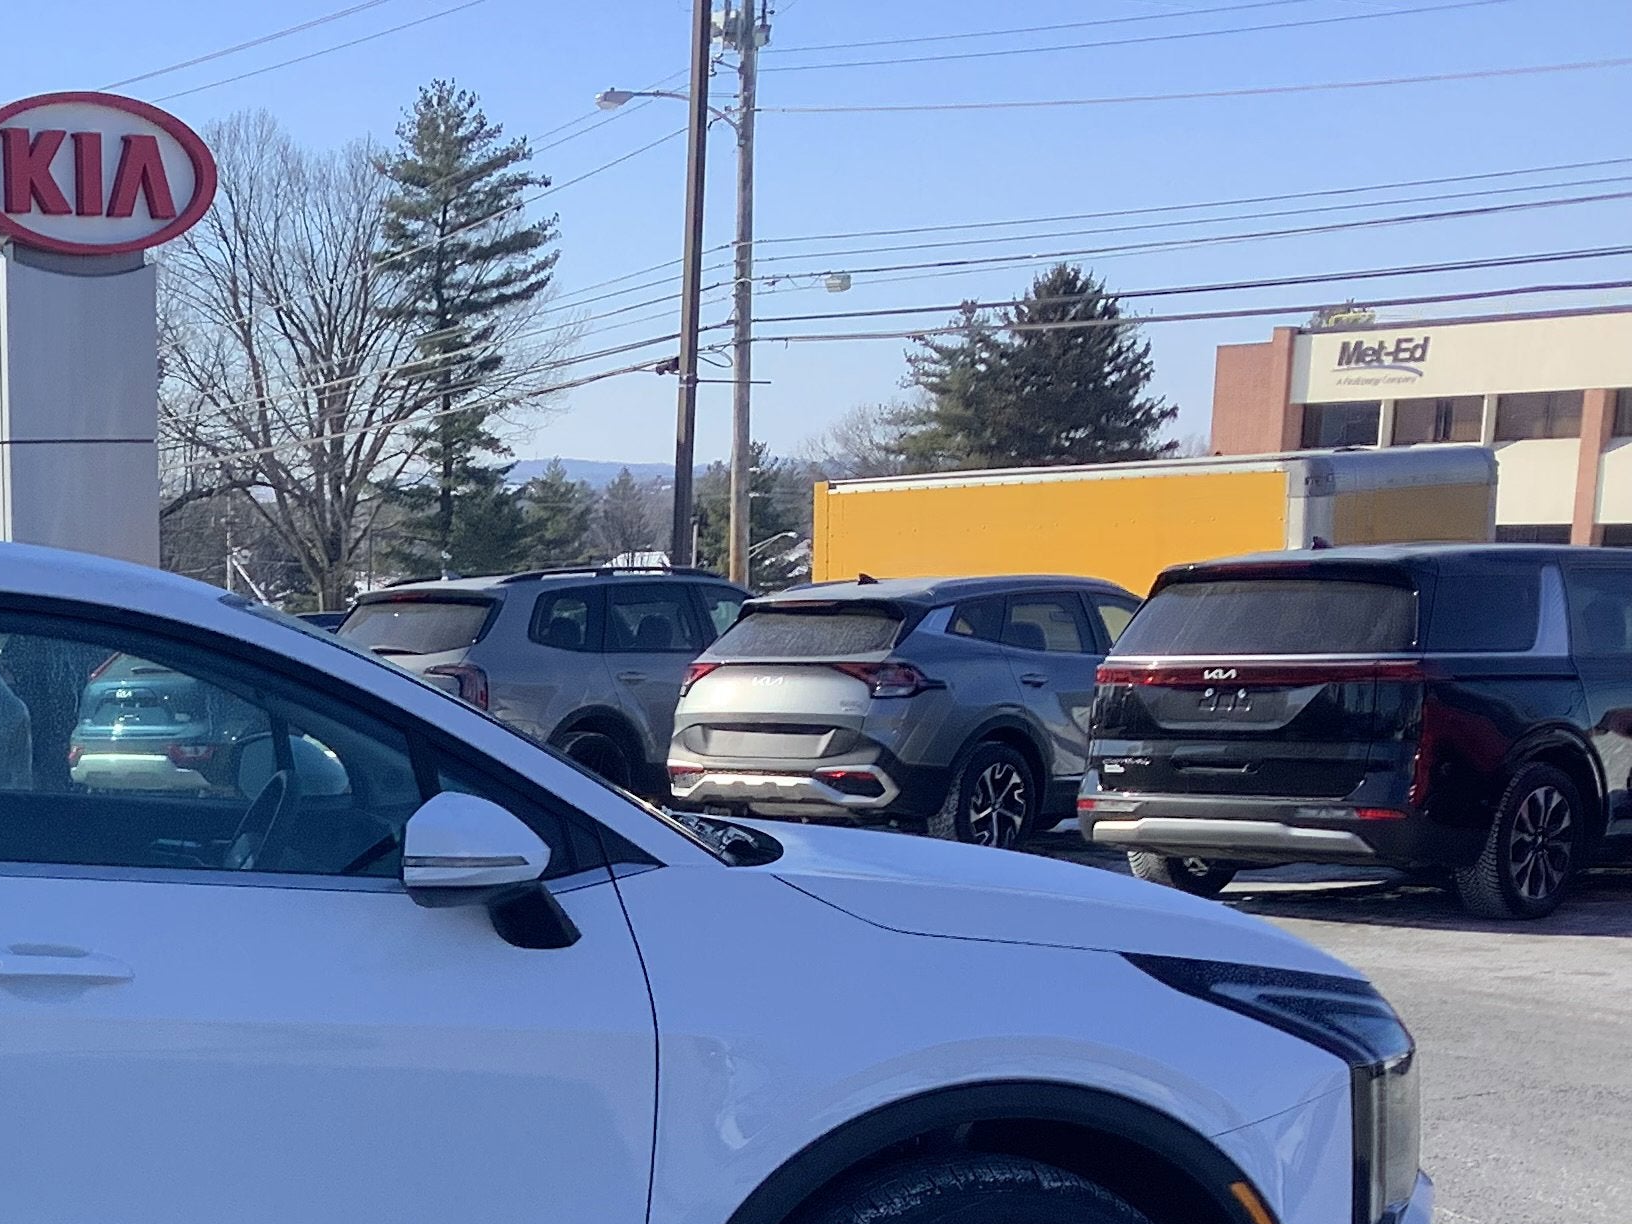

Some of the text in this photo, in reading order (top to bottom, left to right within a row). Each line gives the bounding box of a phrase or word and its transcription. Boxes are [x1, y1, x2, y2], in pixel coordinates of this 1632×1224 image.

[0, 127, 177, 219] KIA
[1337, 336, 1431, 366] Met-Ed
[1203, 668, 1237, 680] KIA
